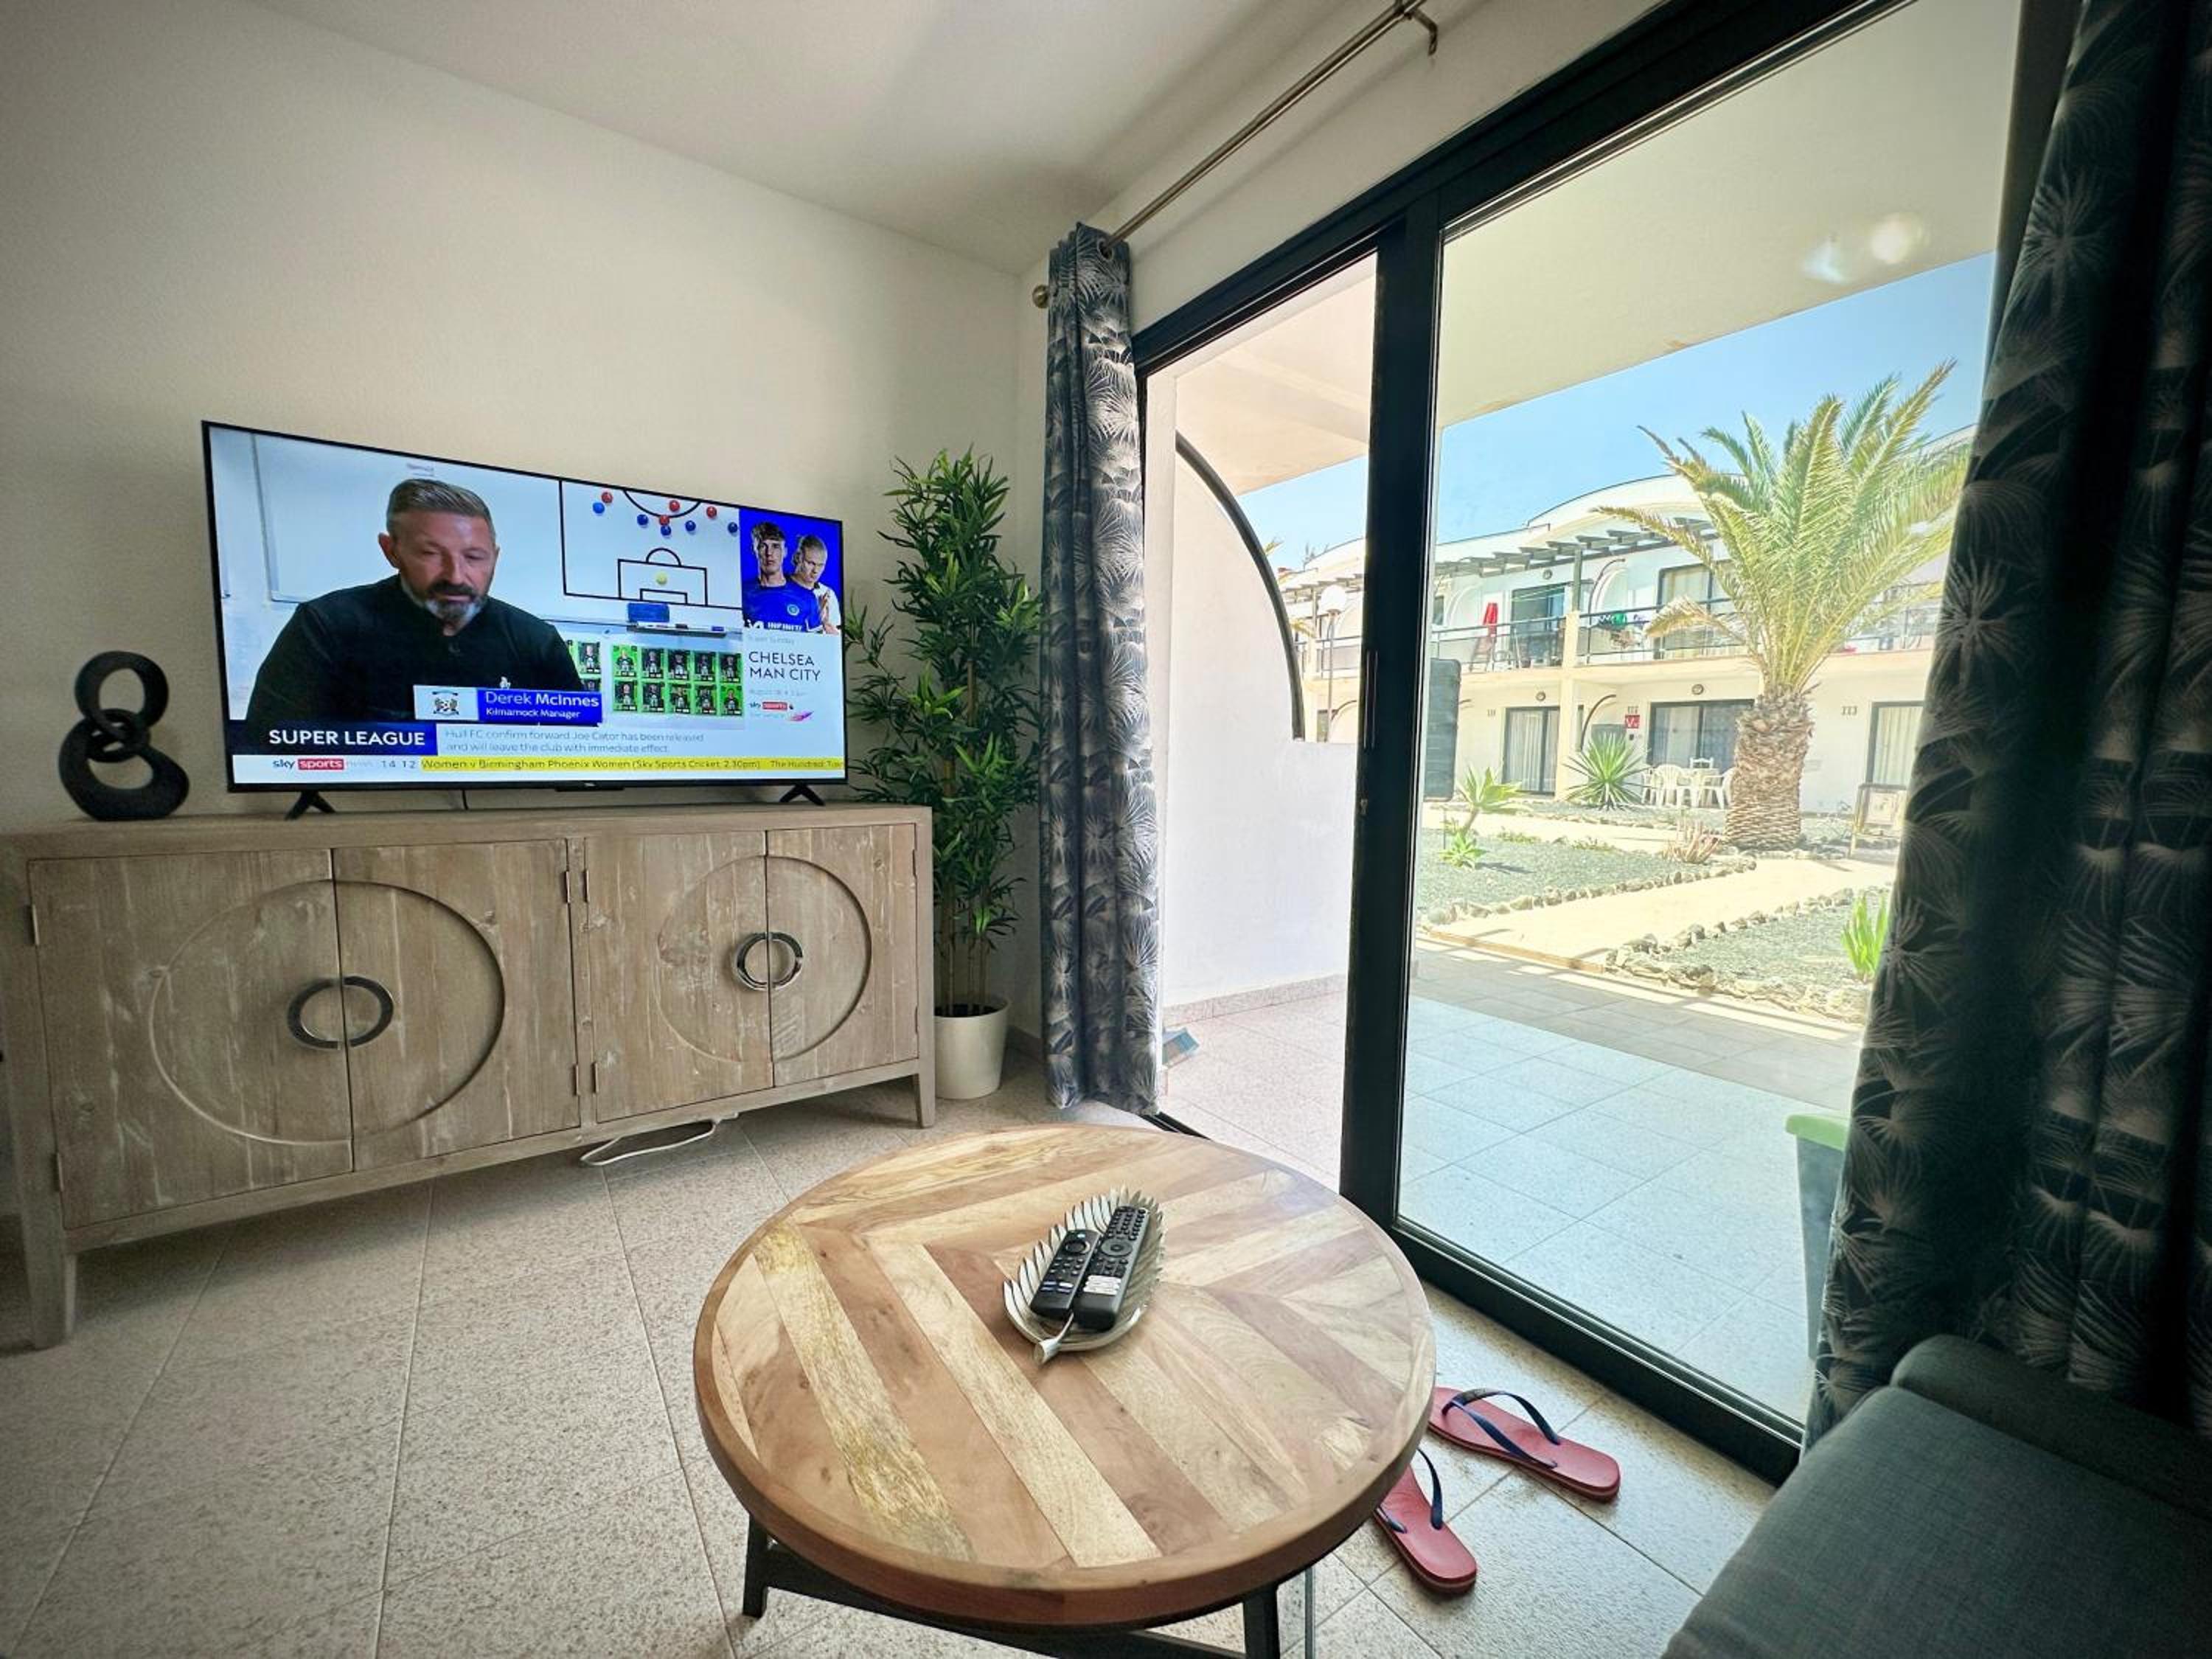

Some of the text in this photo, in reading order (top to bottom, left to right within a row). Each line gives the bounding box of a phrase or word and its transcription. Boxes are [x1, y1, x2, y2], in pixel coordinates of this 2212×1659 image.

[748, 651, 815, 666] CHELSEA
[750, 667, 821, 681] MAN CITY
[485, 691, 599, 707] Derek McInnes
[486, 707, 580, 720] Kilmarnock Manager
[268, 729, 425, 745] SUPER LEAGUE
[485, 730, 528, 738] confirm
[529, 731, 570, 740] forward
[572, 731, 589, 740] Joe
[621, 732, 639, 740] has
[538, 743, 562, 751] club
[589, 744, 640, 752] immediate
[272, 759, 295, 770] sky
[299, 759, 343, 770] sports
[479, 760, 546, 770] Birmingham
[548, 760, 589, 768] Phoenix
[592, 760, 631, 768] Women
[632, 759, 653, 770] (Sky
[655, 760, 686, 770] Sports
[688, 760, 720, 768] Cricket
